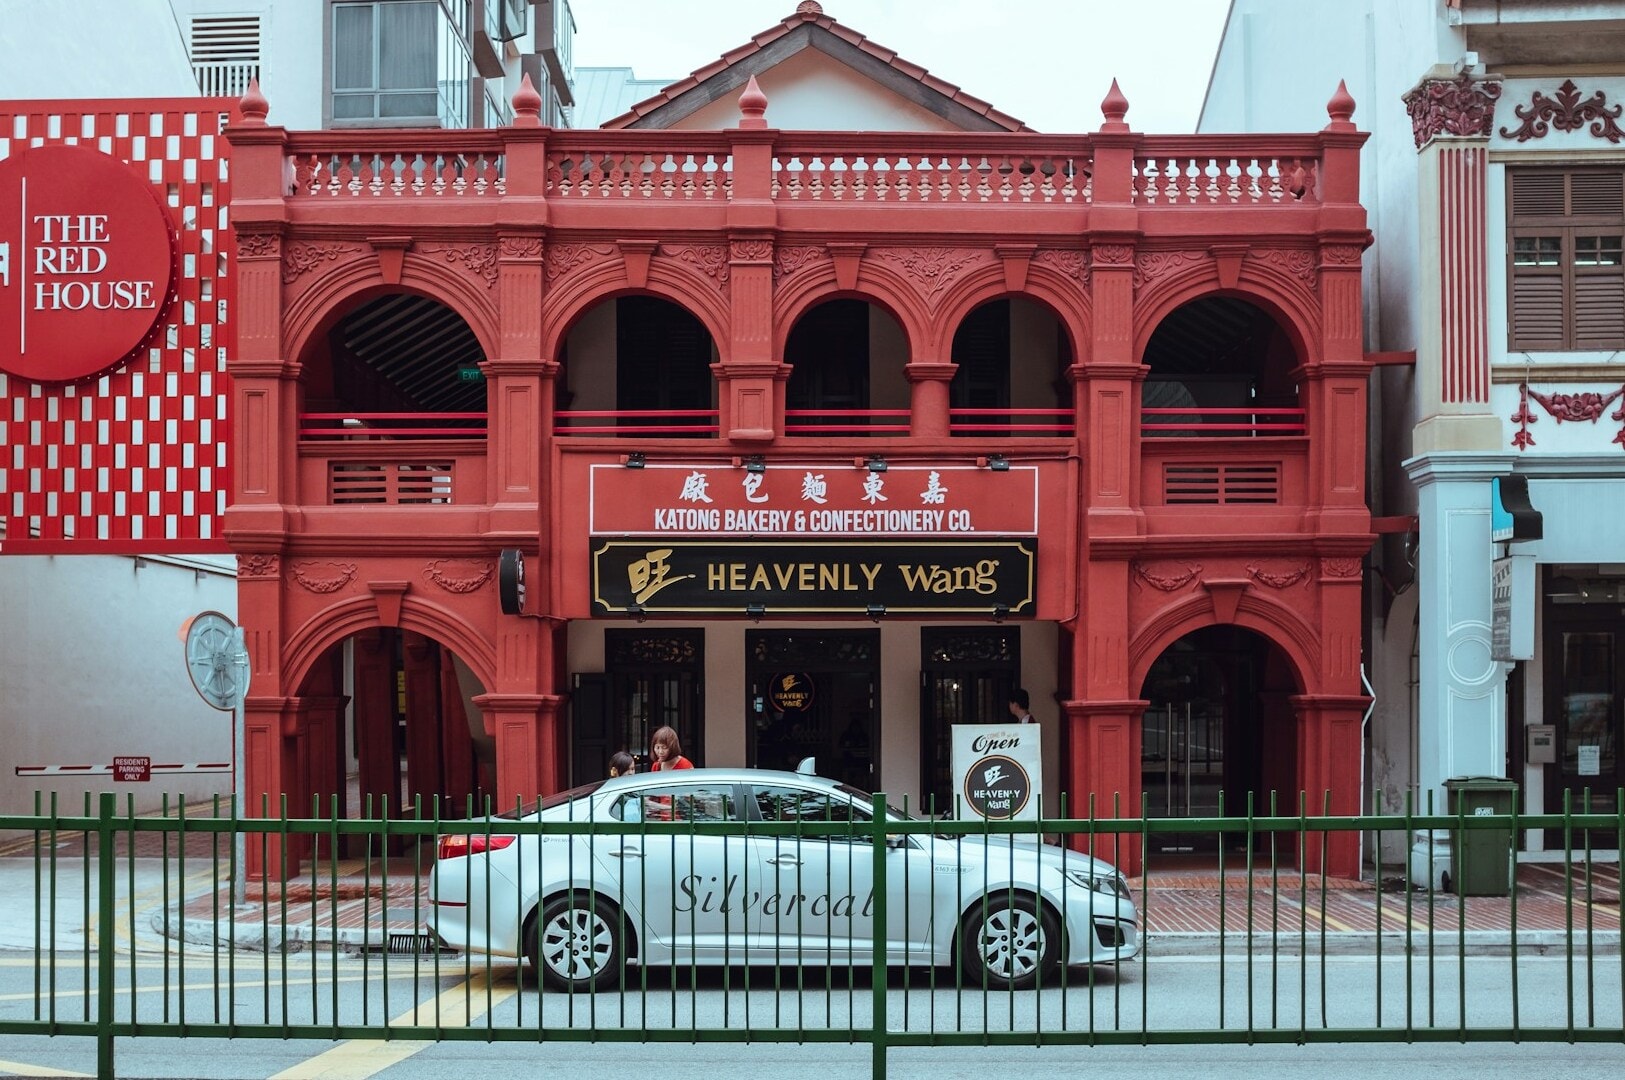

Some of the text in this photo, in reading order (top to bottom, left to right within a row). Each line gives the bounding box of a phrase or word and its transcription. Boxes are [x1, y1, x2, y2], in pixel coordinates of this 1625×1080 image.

[34, 215, 110, 243] THE
[34, 246, 107, 274] RED
[34, 280, 156, 310] HOUSE
[463, 371, 480, 380] EXIT
[655, 508, 975, 532] KATONG BAKERY & CONFECTIONERY CO.
[708, 559, 1000, 595] HEAVENLY Wang
[775, 692, 809, 700] HEAVENLY
[971, 735, 1021, 755] Open
[115, 758, 149, 766] RESIDENTS
[118, 765, 145, 773] PARKING
